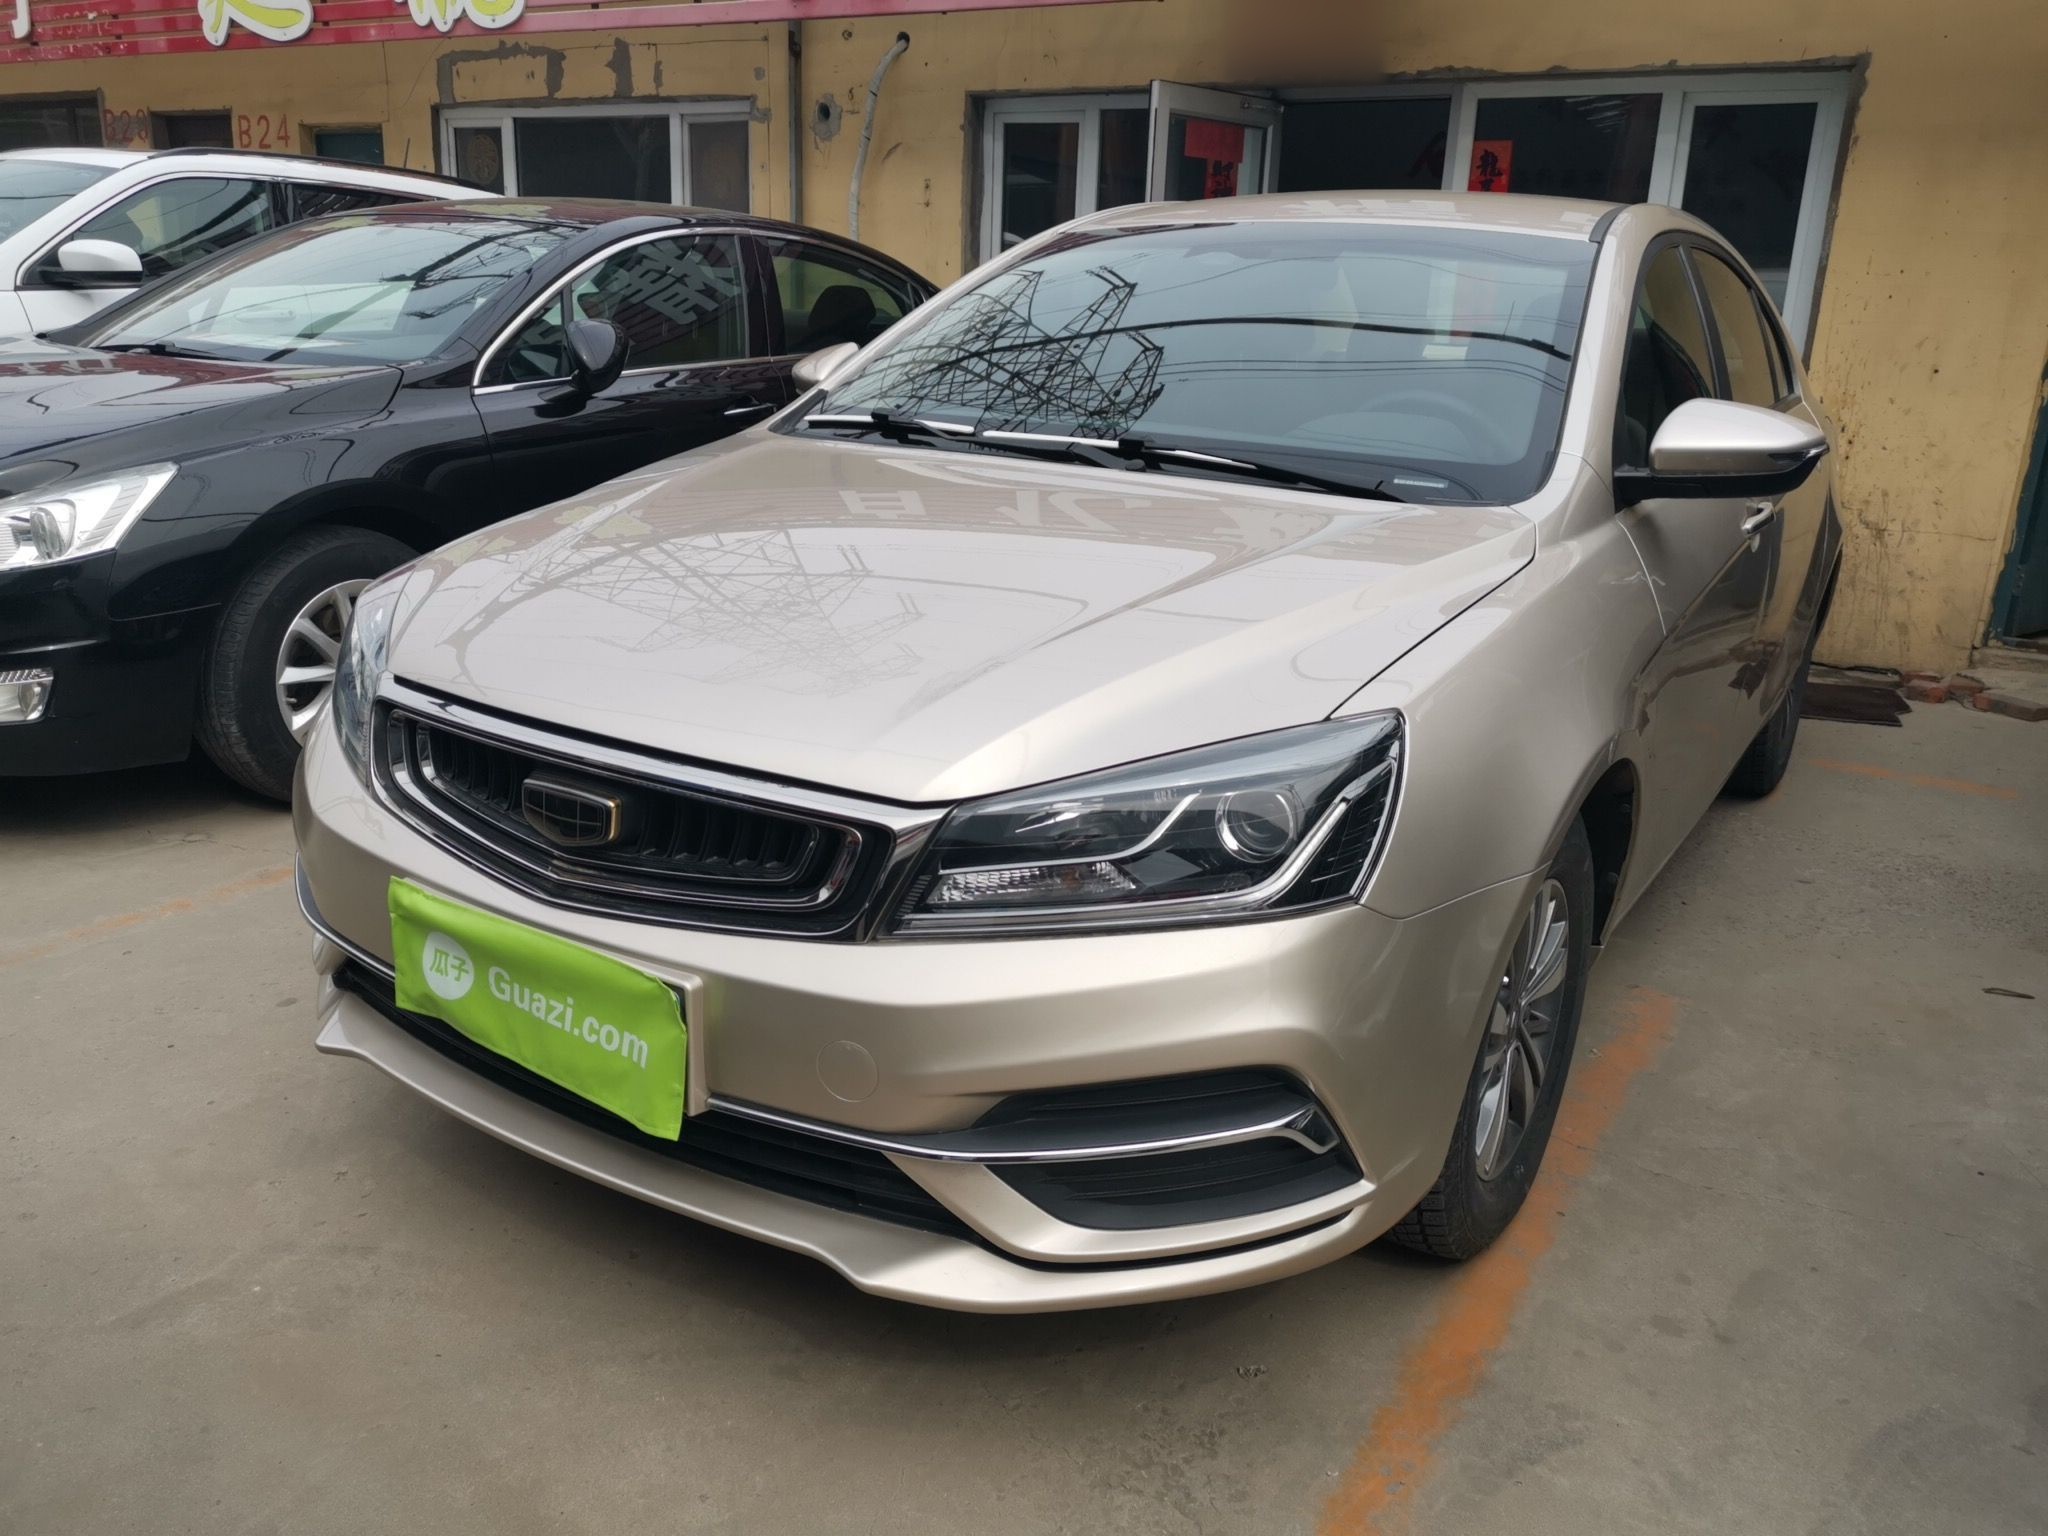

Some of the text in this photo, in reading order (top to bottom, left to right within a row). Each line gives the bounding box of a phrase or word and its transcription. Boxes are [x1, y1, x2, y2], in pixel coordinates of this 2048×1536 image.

[237, 114, 291, 149] B24
[429, 947, 470, 983] 瓜子
[488, 965, 649, 1071] Guazi.com
